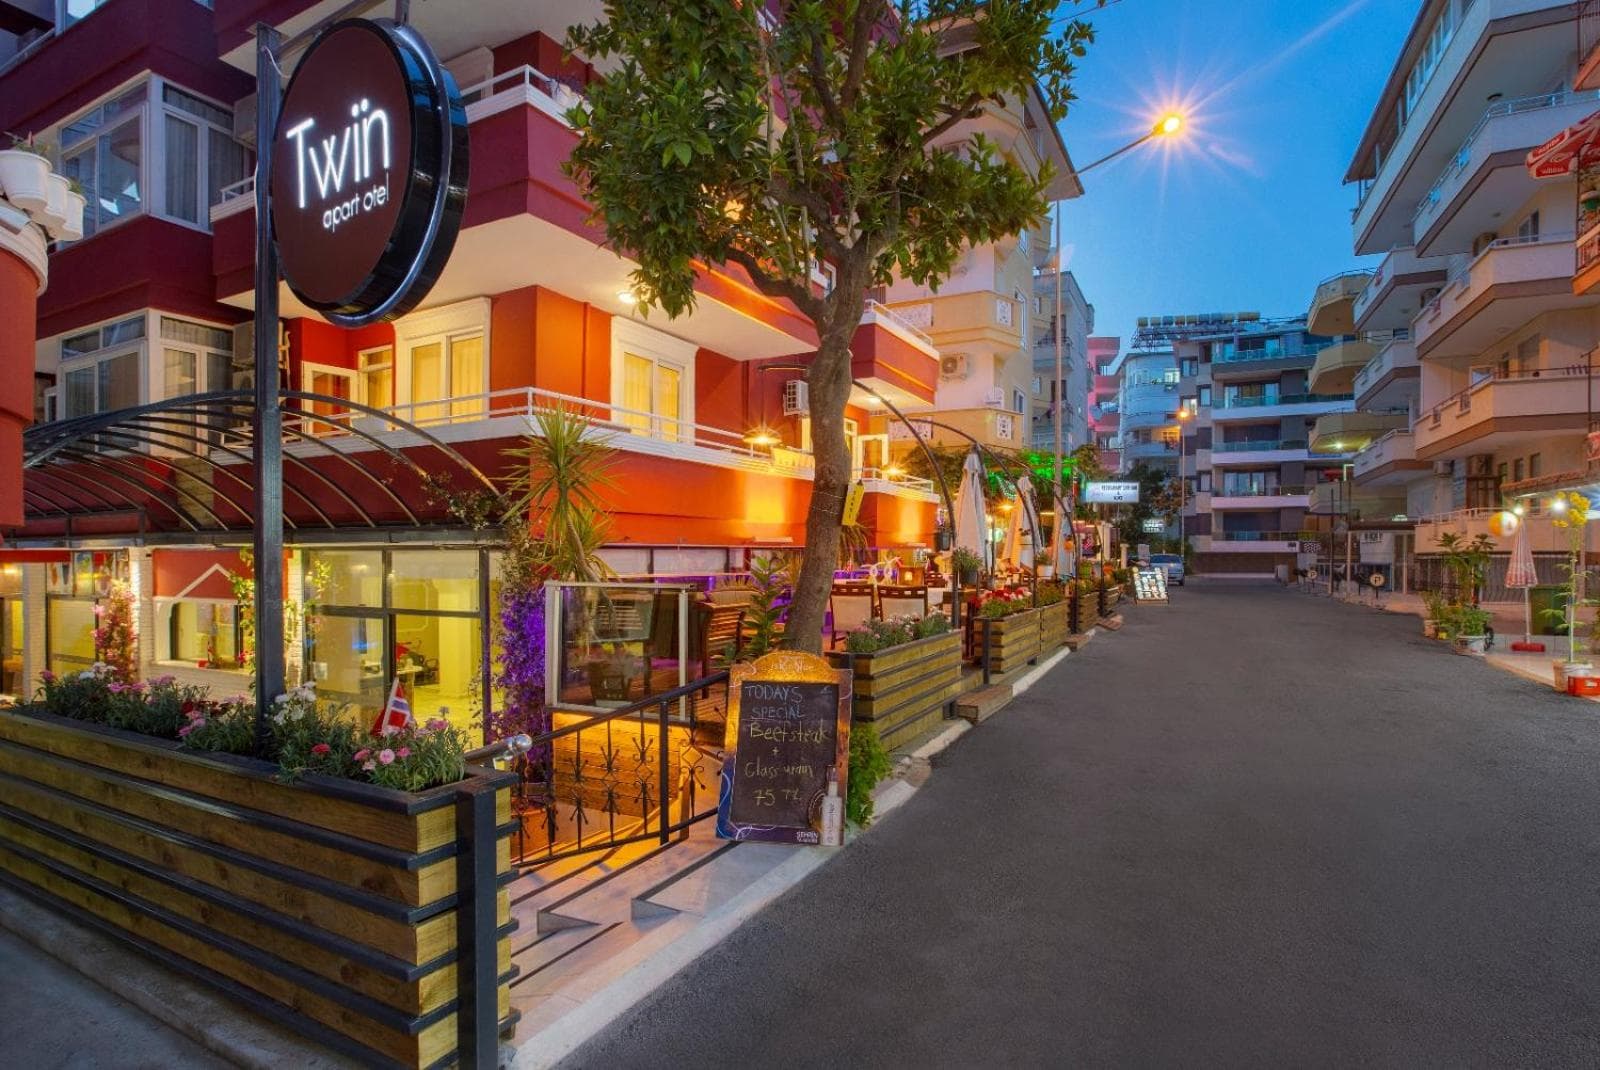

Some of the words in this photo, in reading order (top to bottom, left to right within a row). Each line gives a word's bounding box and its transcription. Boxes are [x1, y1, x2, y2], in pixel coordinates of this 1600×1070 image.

[286, 98, 390, 208] Twin
[323, 193, 360, 232] apart
[363, 172, 389, 211] otel
[751, 704, 806, 720] SPECIAL
